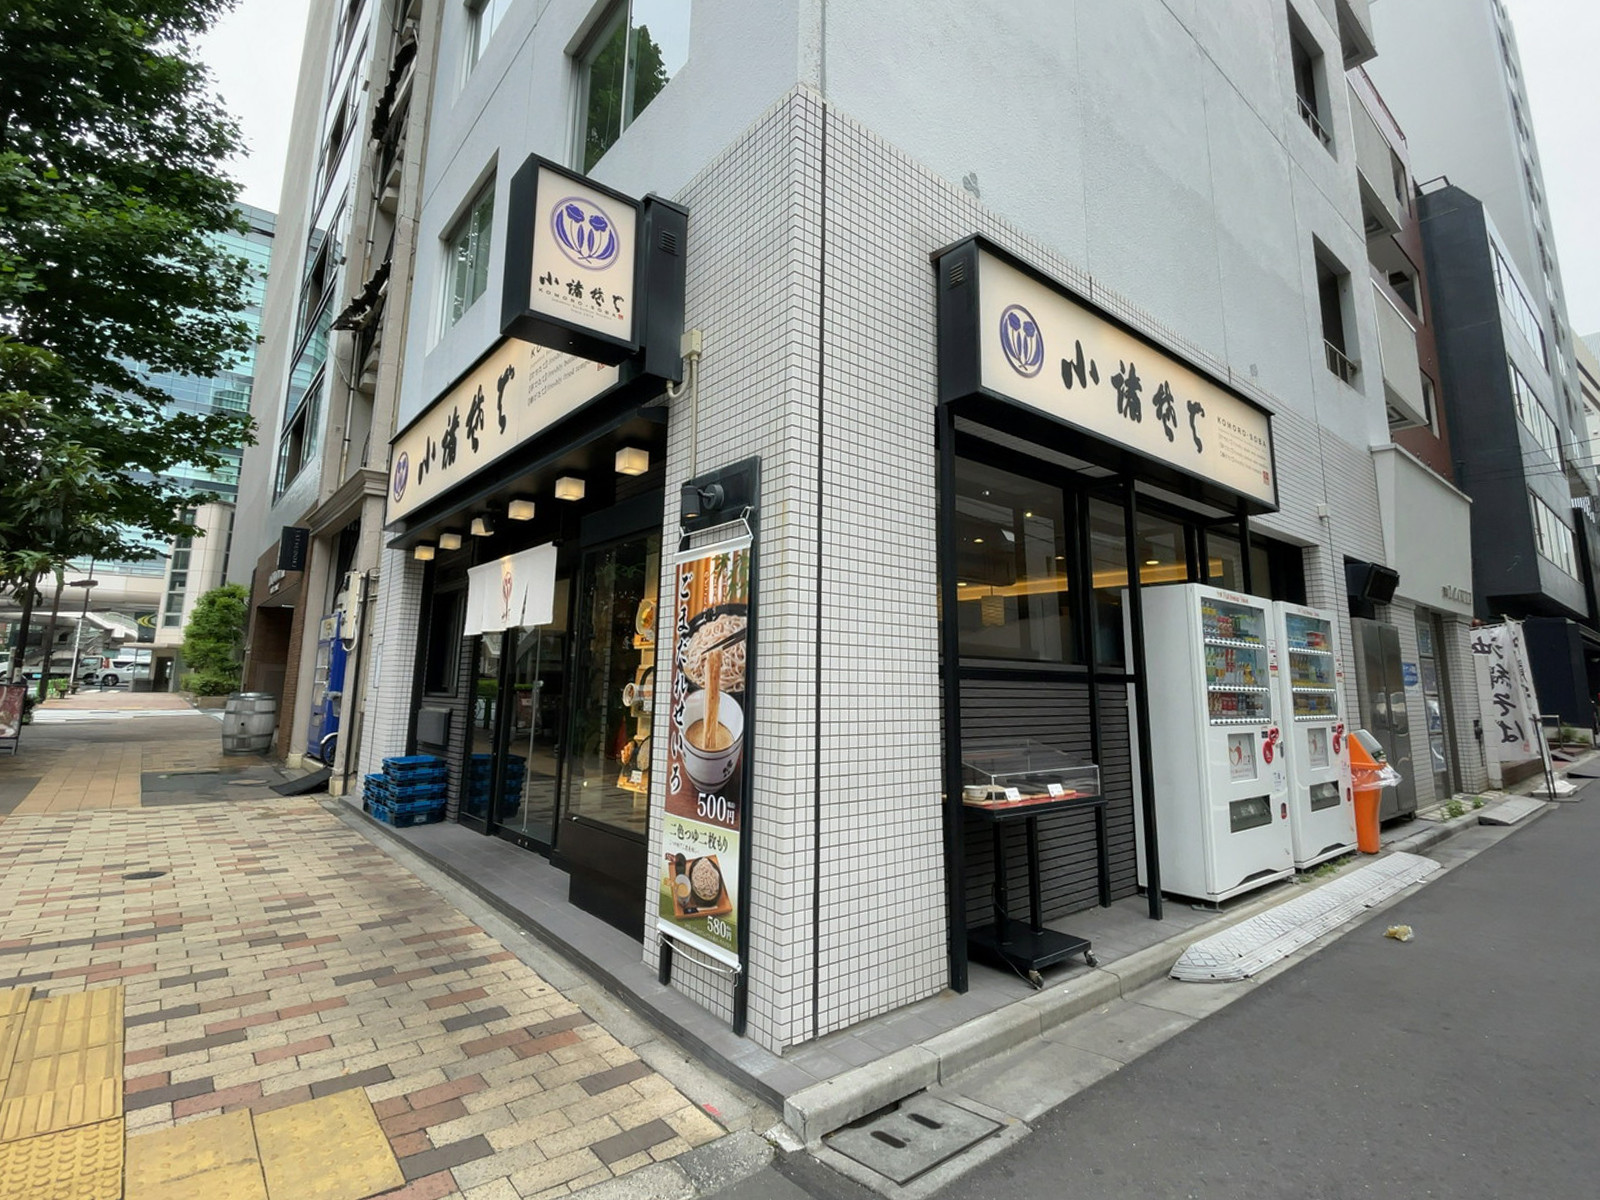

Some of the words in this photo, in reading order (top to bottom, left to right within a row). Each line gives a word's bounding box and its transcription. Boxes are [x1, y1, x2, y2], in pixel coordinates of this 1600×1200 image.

[670, 571, 693, 795] ごまだれせいろ
[669, 823, 729, 853] 二色つゆ二枚もり
